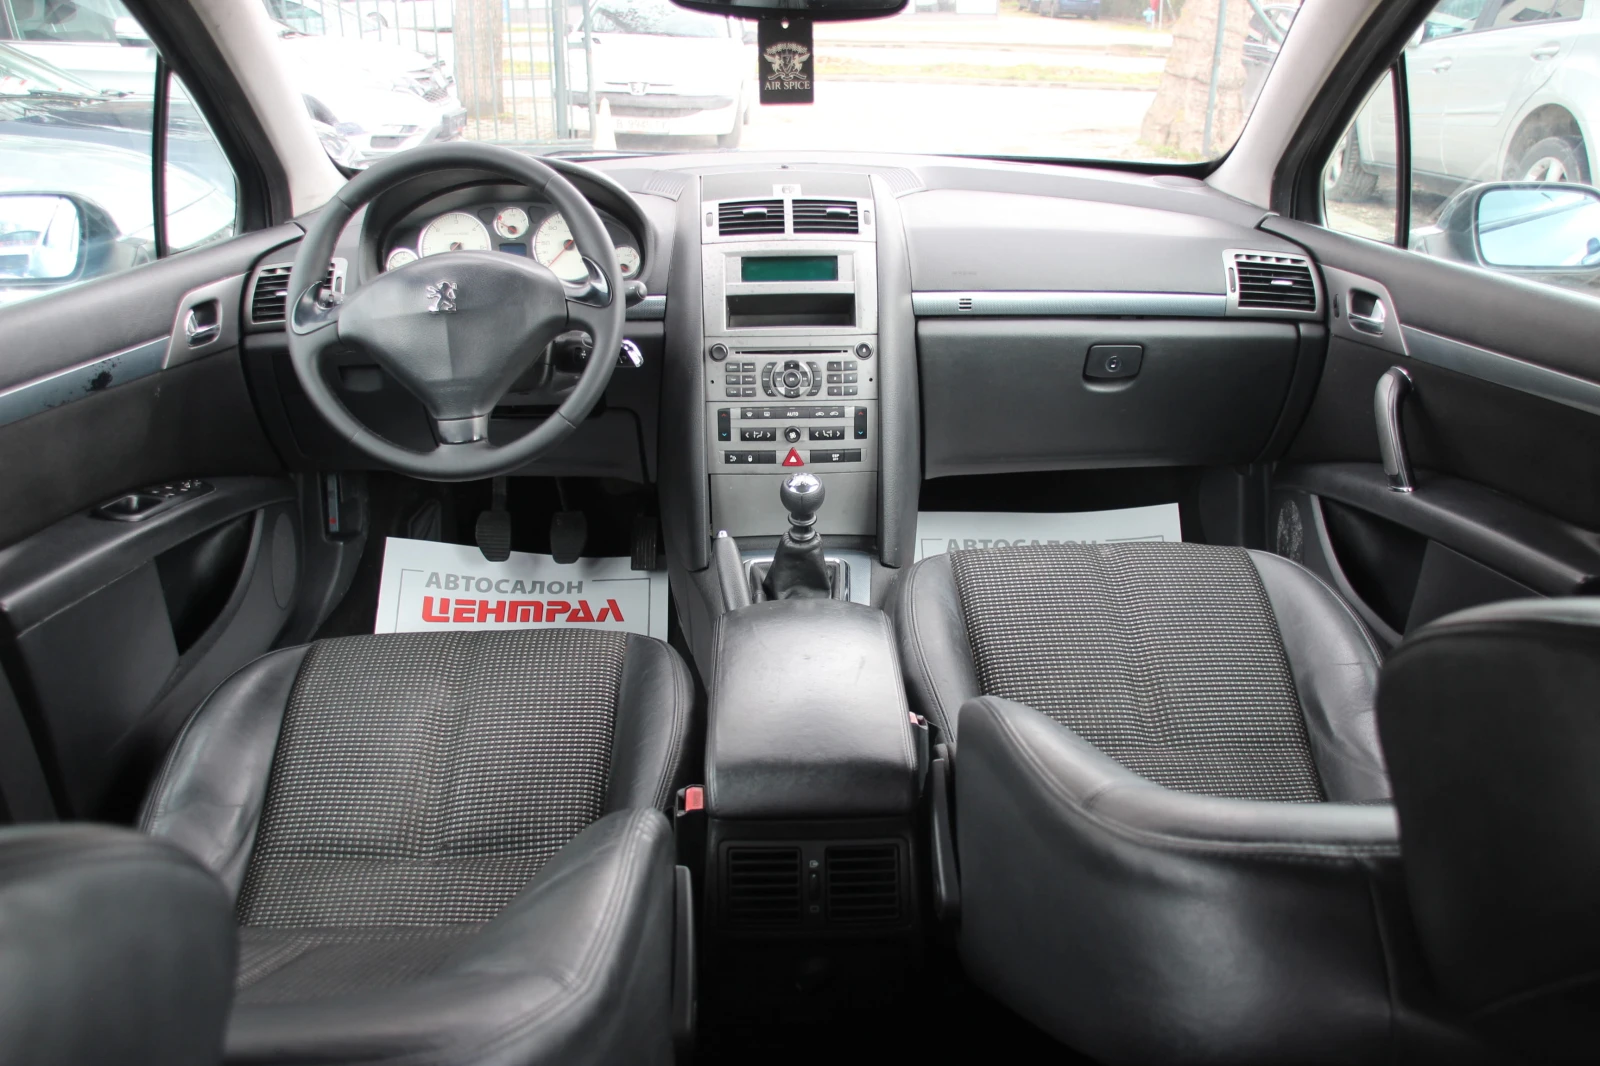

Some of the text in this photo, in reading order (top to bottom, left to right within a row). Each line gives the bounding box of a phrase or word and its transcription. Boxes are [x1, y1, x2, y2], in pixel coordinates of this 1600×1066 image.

[764, 81, 811, 90] AIR SPICE
[425, 571, 584, 594] АВТОСАЛОН
[422, 595, 625, 623] ЦЕНТРАЛ
